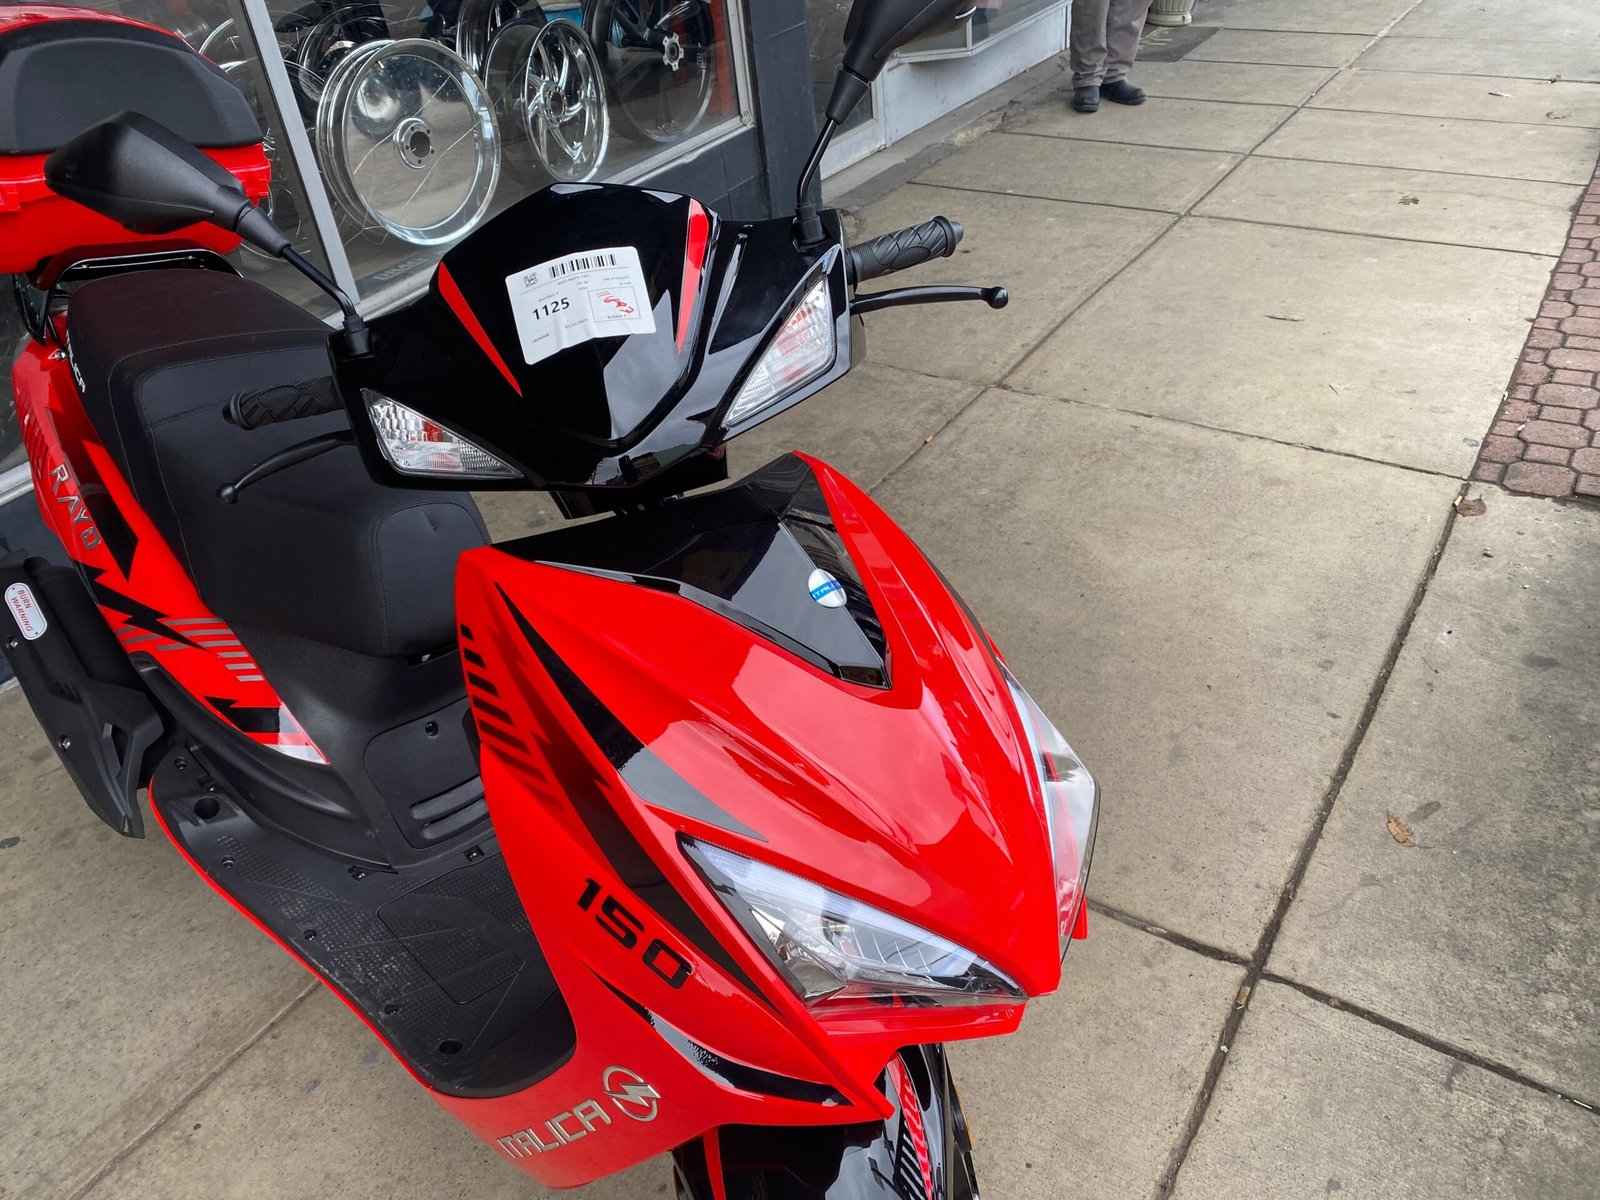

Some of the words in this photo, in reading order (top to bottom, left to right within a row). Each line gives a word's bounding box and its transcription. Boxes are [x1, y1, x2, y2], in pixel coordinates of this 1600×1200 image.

[532, 296, 571, 321] 1125
[51, 463, 103, 551] RAYO
[11, 596, 34, 632] WARNING
[17, 589, 32, 609] BURN
[576, 877, 694, 991] 150
[497, 1098, 612, 1159] ITALICA
